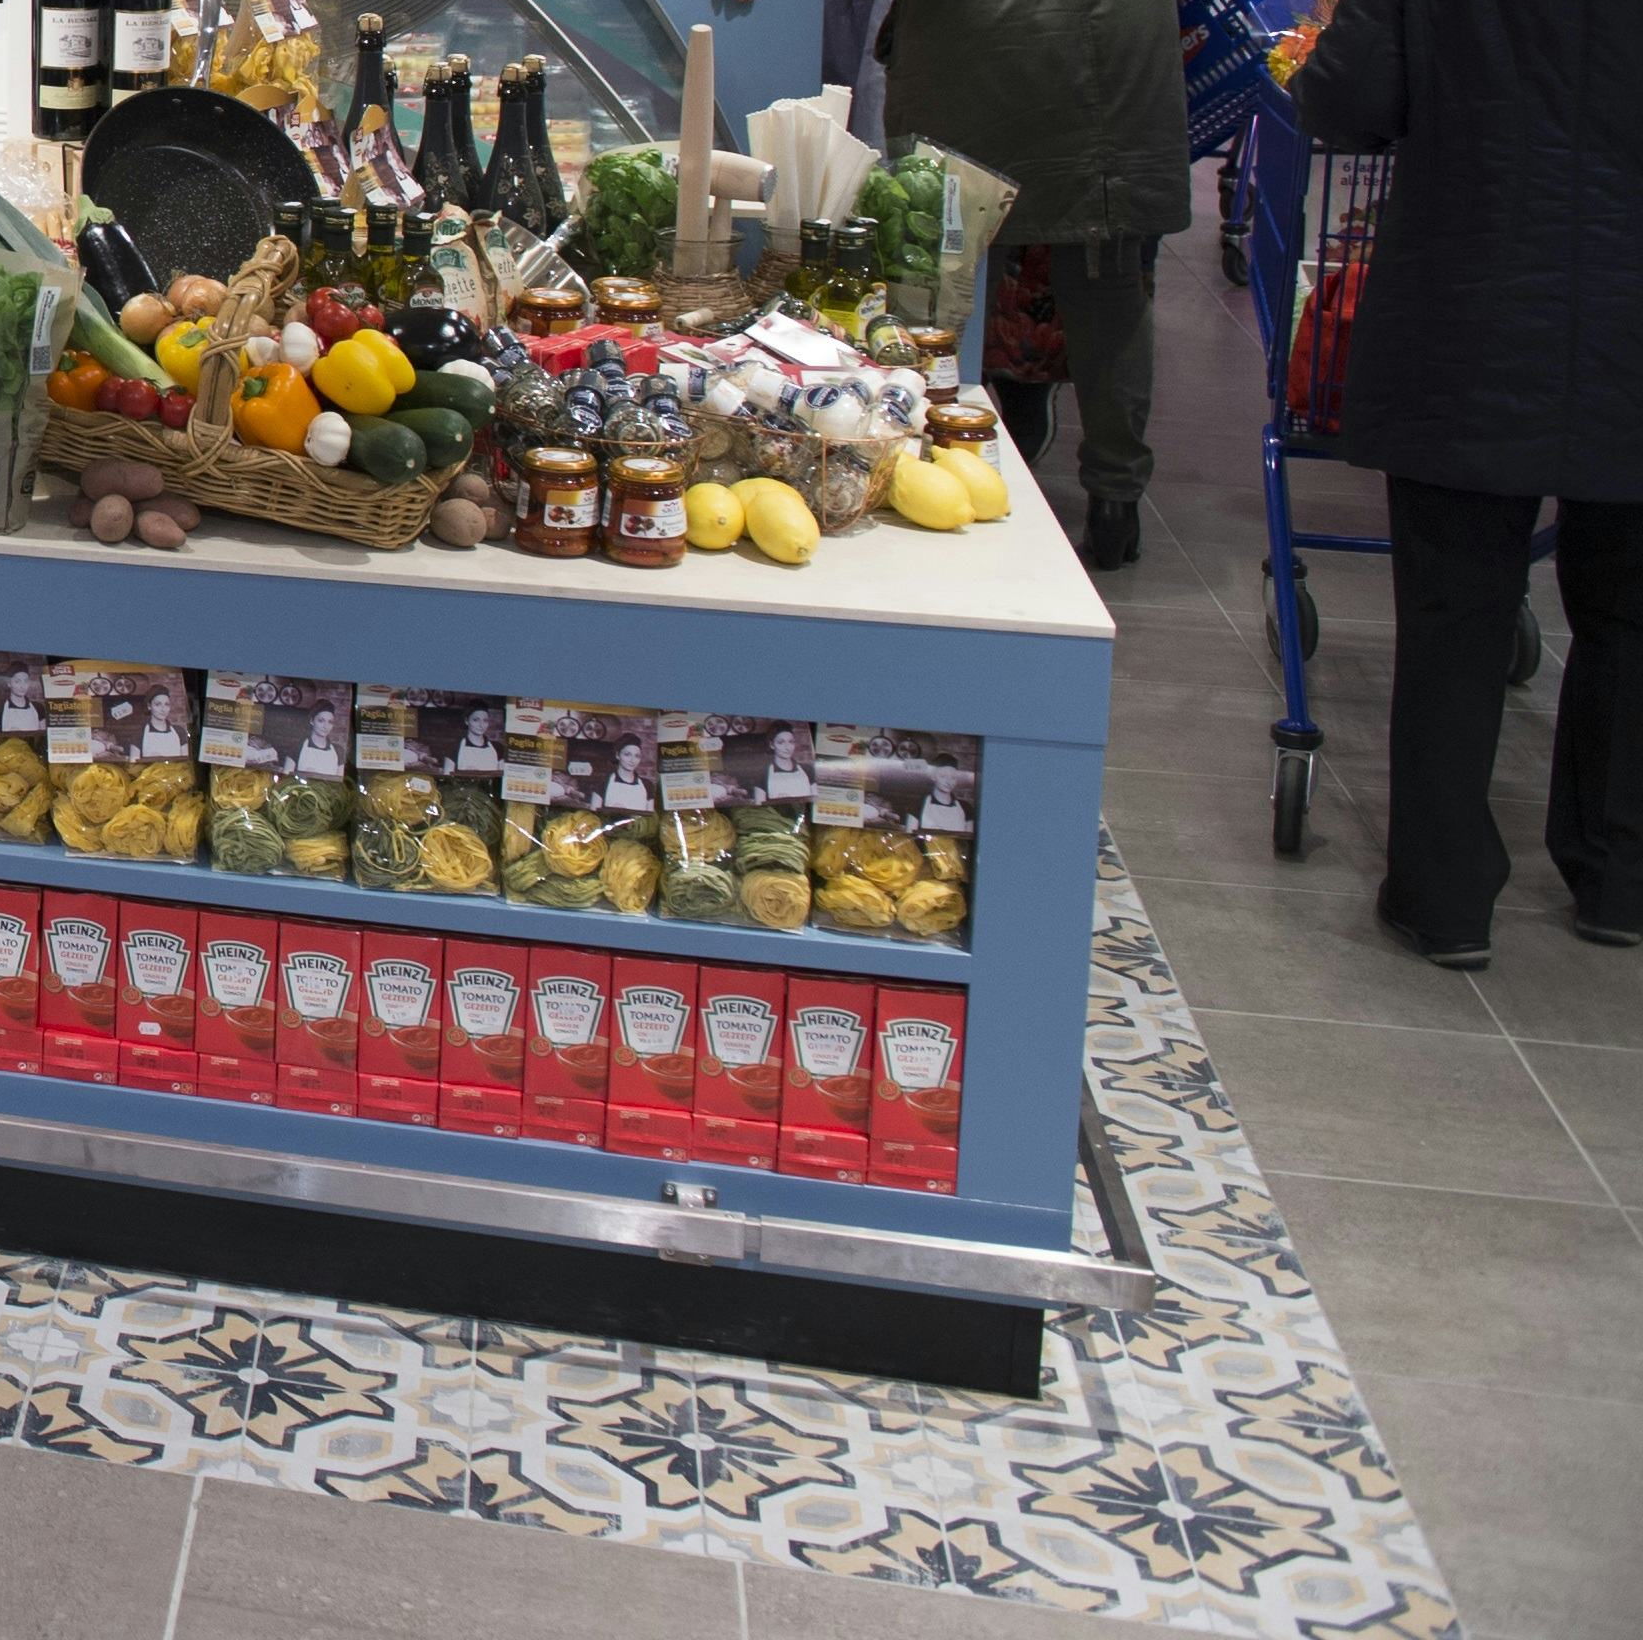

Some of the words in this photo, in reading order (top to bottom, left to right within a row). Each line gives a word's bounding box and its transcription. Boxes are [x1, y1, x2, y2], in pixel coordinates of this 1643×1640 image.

[59, 924, 98, 939] HEINZ
[58, 940, 99, 954] TOMATO
[137, 936, 177, 951] HEINZ
[60, 951, 94, 961] GEZEEFD
[135, 952, 178, 966] TOMATO
[216, 946, 257, 962] HEINZ
[138, 963, 173, 974] GEZEEFD
[298, 958, 337, 973] HEINZ
[381, 965, 421, 981] HEINZ
[378, 982, 423, 996] TOMATO
[464, 974, 506, 989] HEINZ
[461, 991, 506, 1005] TOMATO
[548, 983, 589, 998] HEINZ
[381, 993, 417, 1004] GEZEEFD
[632, 993, 674, 1008] HEINZ
[464, 1002, 501, 1013] GEZEEFD
[718, 1002, 761, 1018] HEINZ
[629, 1010, 676, 1024] TOMATO
[807, 1013, 851, 1029] HEINZ
[633, 1021, 671, 1032] GEZEEFD
[716, 1019, 763, 1034] TOMATO
[897, 1025, 941, 1041] HEINZ
